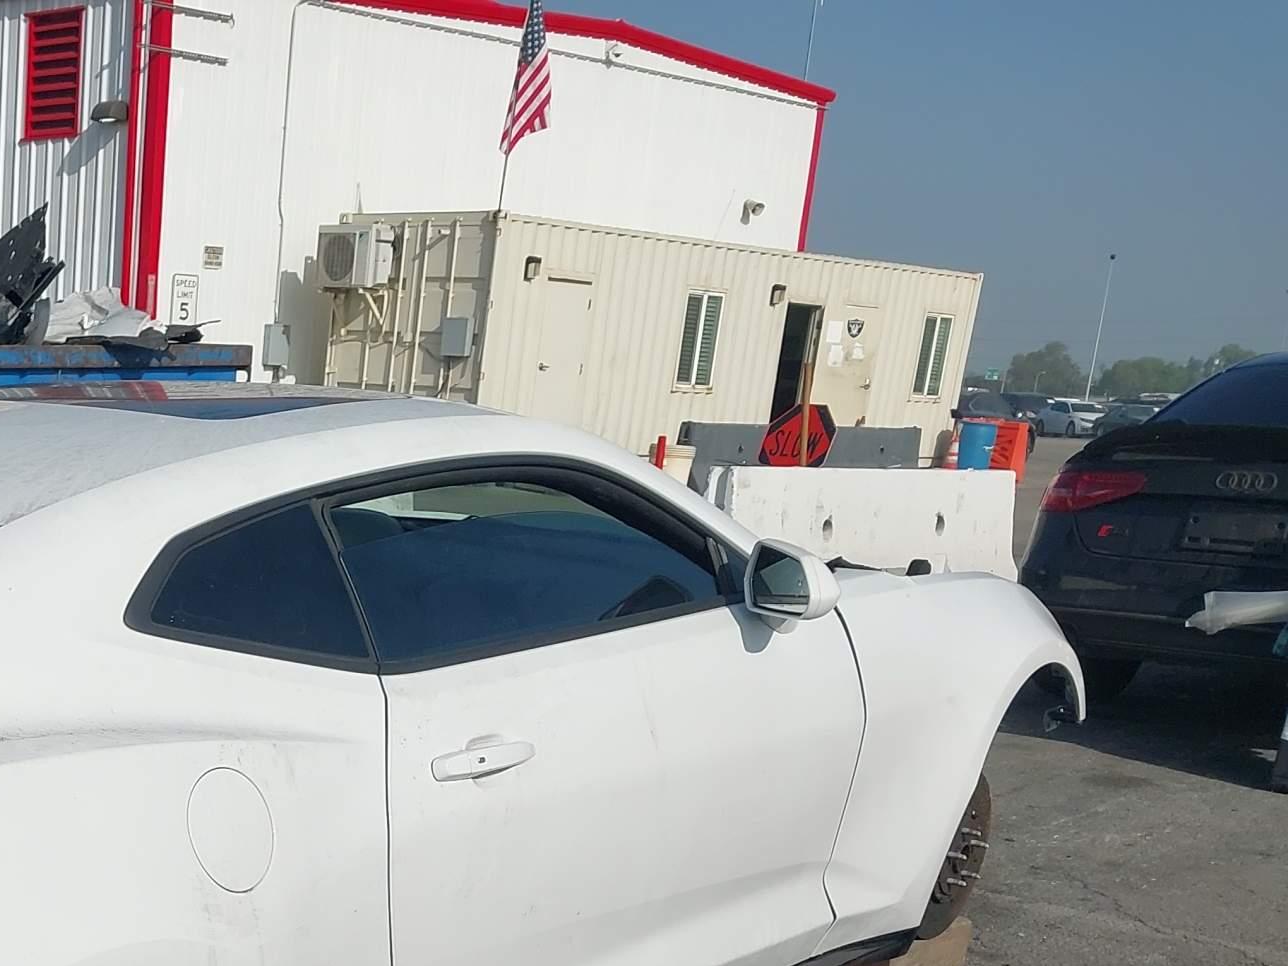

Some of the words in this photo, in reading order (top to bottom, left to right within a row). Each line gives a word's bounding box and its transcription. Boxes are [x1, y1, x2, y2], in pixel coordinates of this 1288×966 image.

[175, 279, 197, 289] SPEED
[176, 290, 194, 300] LIMIT
[178, 301, 190, 321] 5
